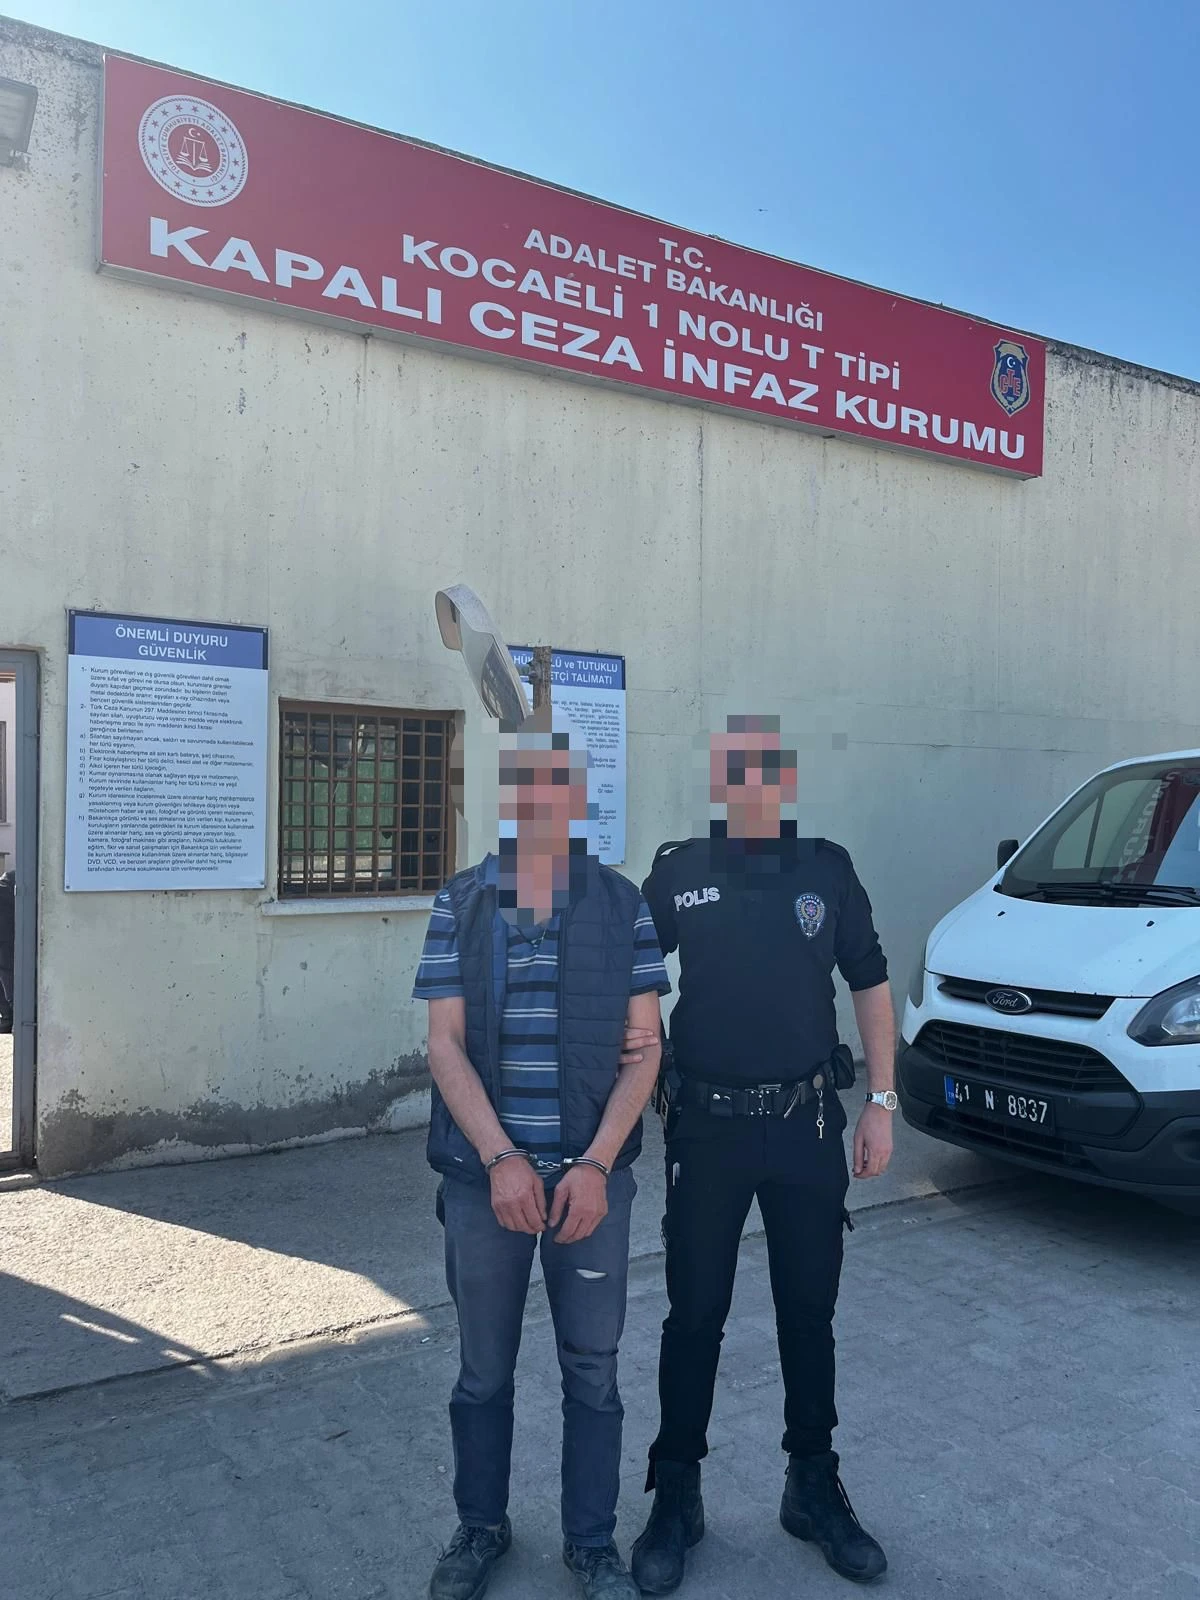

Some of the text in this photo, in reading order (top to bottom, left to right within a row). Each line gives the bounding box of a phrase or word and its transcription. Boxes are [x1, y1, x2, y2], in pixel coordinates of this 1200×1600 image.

[659, 238, 711, 272] T.C.
[524, 229, 823, 331] ADALET BAKANLIĞI
[403, 234, 900, 390] KOCAELİ 1 NOLU T TİPİ
[150, 217, 1024, 459] KAPALI CEZA İNFAZ KURUMU
[115, 624, 228, 648] ÖNEMLİ DUYURU
[138, 644, 207, 661] GÜVENLİK
[564, 661, 575, 669] ve
[577, 660, 618, 672] TUTUKLU
[571, 672, 612, 684] TALİMATI
[992, 992, 1017, 1008] Ford
[985, 1090, 994, 1110] N
